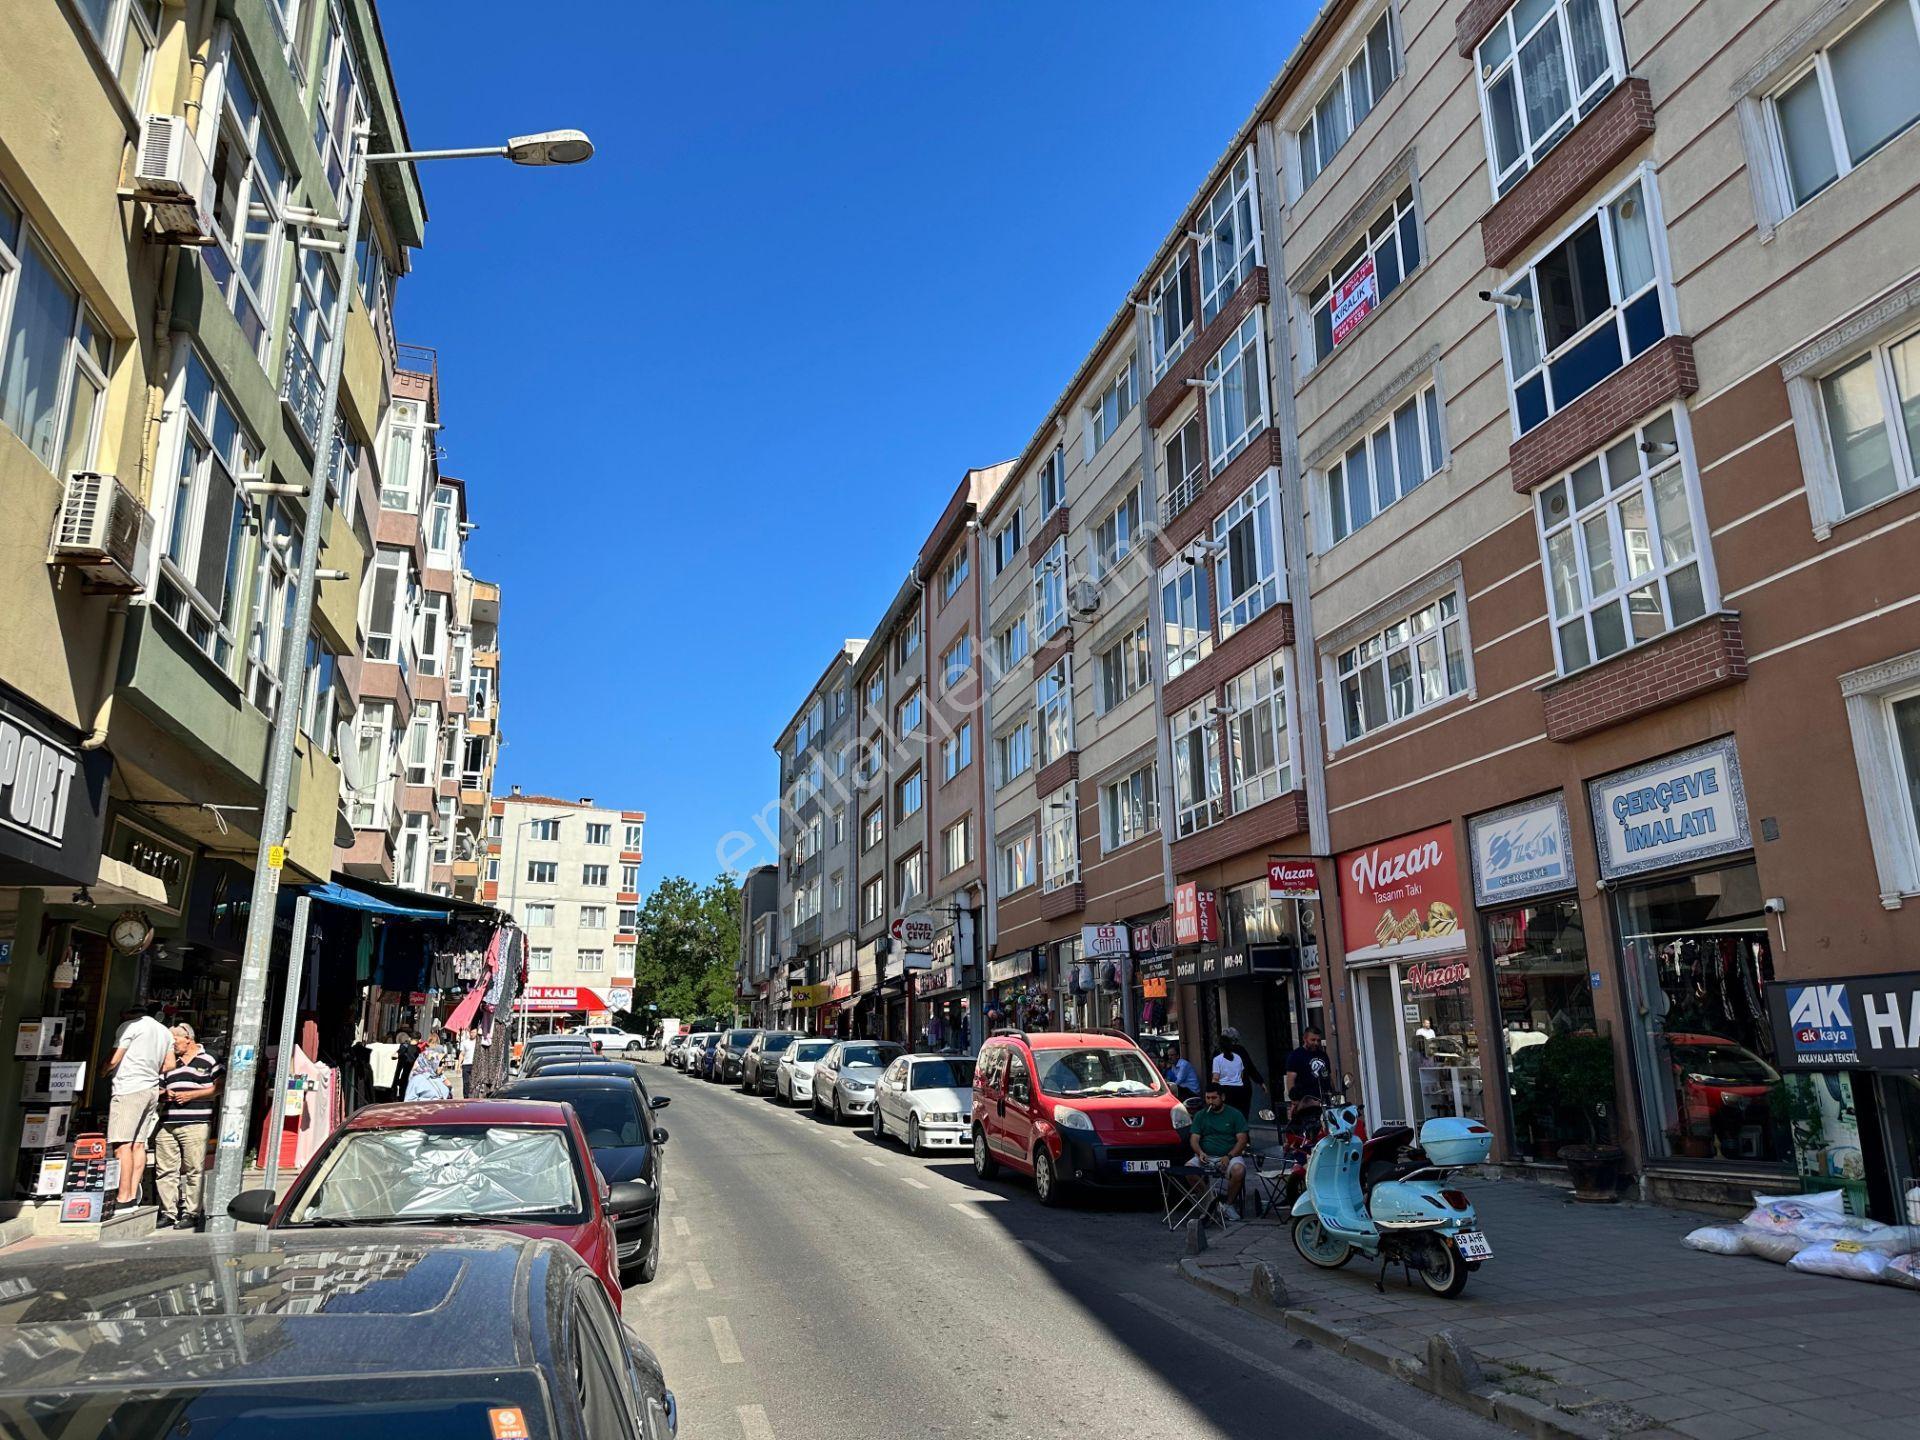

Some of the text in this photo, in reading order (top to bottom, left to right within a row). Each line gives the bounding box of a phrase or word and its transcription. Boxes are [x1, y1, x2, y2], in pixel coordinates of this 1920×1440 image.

[1334, 286, 1365, 322] KIRALIK
[1612, 767, 1719, 825] ÇERÇEVE
[1623, 806, 1717, 853] İMALATI
[1271, 865, 1315, 881] Nazan
[1351, 840, 1443, 894] Nazan
[1498, 867, 1548, 886] ÇERÇEVE
[1176, 887, 1194, 915] CC
[1373, 883, 1422, 905] Tasarım Takı
[905, 921, 933, 932] GÜZEL
[907, 931, 932, 941] ÇEYİZ
[1099, 928, 1114, 937] CC
[1134, 928, 1149, 951] CC
[1176, 962, 1195, 977] DOĞAN
[1407, 962, 1467, 992] Nazan
[1789, 984, 1853, 1028] AK
[1801, 1029, 1847, 1043] ak kaya
[1797, 1050, 1860, 1064] AKKAYALAR TEKSTİL
[1455, 1234, 1468, 1245] 59
